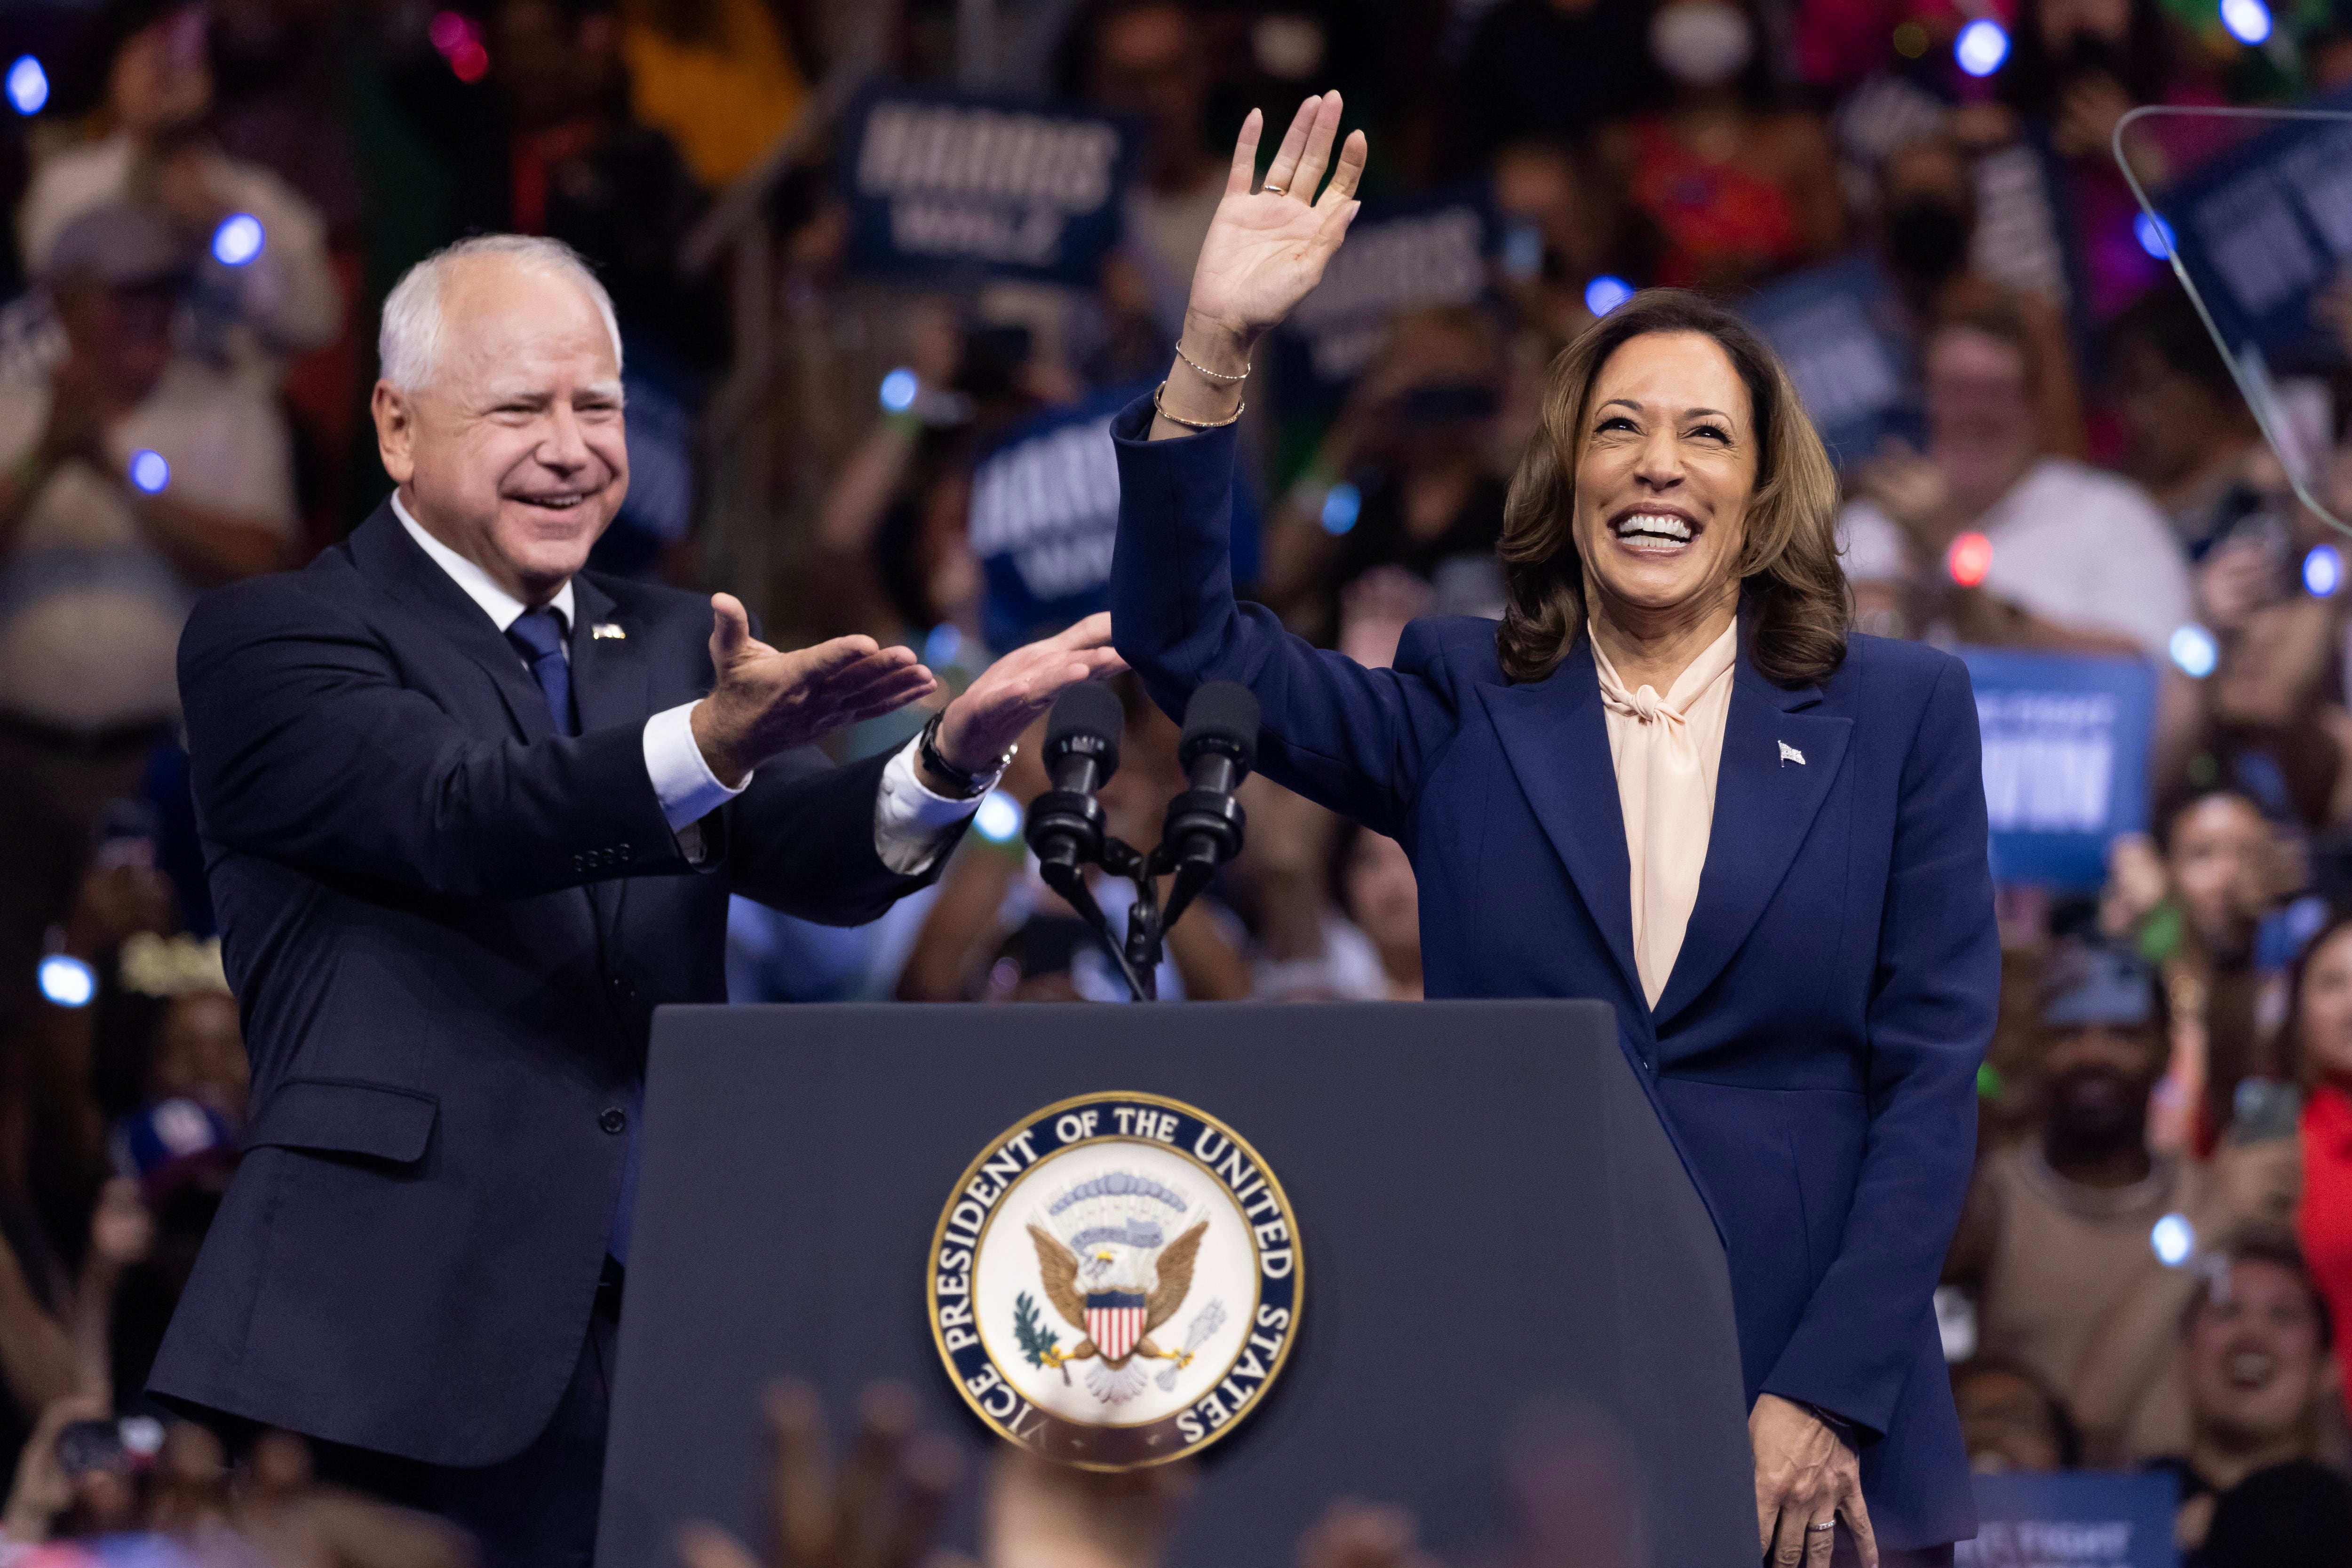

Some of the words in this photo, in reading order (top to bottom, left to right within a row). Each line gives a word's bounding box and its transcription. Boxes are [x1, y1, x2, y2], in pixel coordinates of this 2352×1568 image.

[858, 103, 1120, 213] HARRIS
[891, 199, 1064, 265] WALZ
[1056, 1110, 1098, 1143] OF
[1113, 1108, 1179, 1143] THE
[938, 1130, 1038, 1352] PRESIDENT
[1194, 1123, 1293, 1279] UNITED
[1176, 1304, 1290, 1444] STATES
